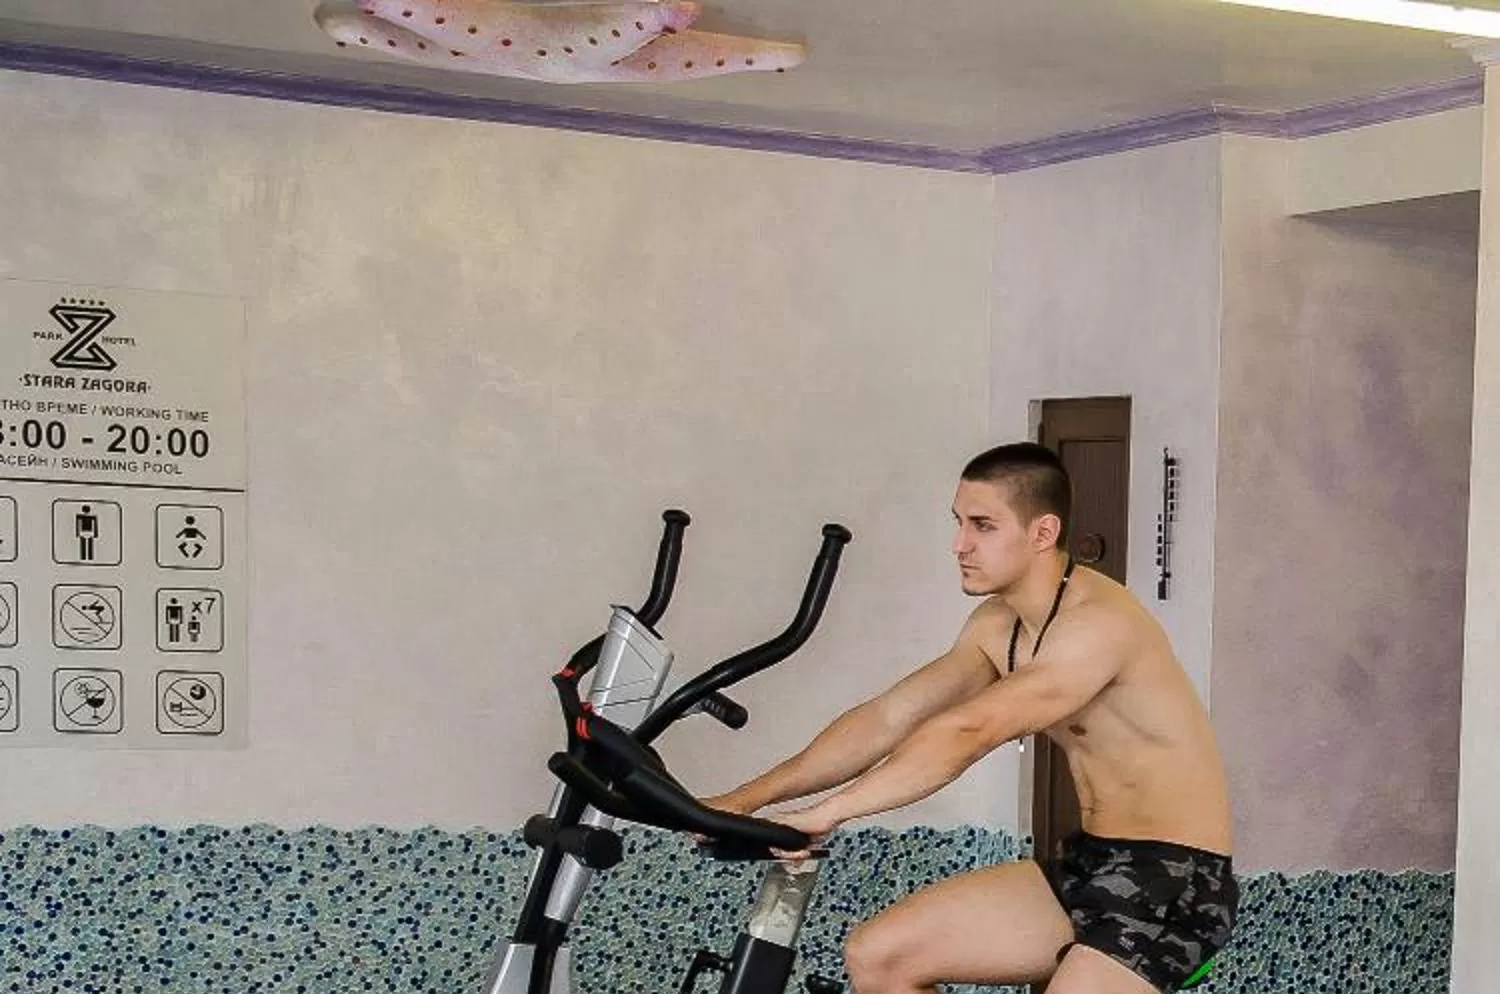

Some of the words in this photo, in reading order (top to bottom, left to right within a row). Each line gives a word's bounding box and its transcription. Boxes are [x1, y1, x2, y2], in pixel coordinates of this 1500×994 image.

[33, 331, 64, 341] PARK
[101, 336, 136, 346] HOTEL
[23, 374, 76, 389] STARA
[81, 377, 147, 394] ZAGORA
[36, 402, 87, 415] ВРЕМЕ
[101, 405, 171, 421] WORKING
[176, 409, 209, 422] TIME
[0, 419, 66, 450] :00
[106, 423, 209, 458] 20:00
[61, 458, 138, 473] SWIMMING
[143, 461, 183, 475] POOL
